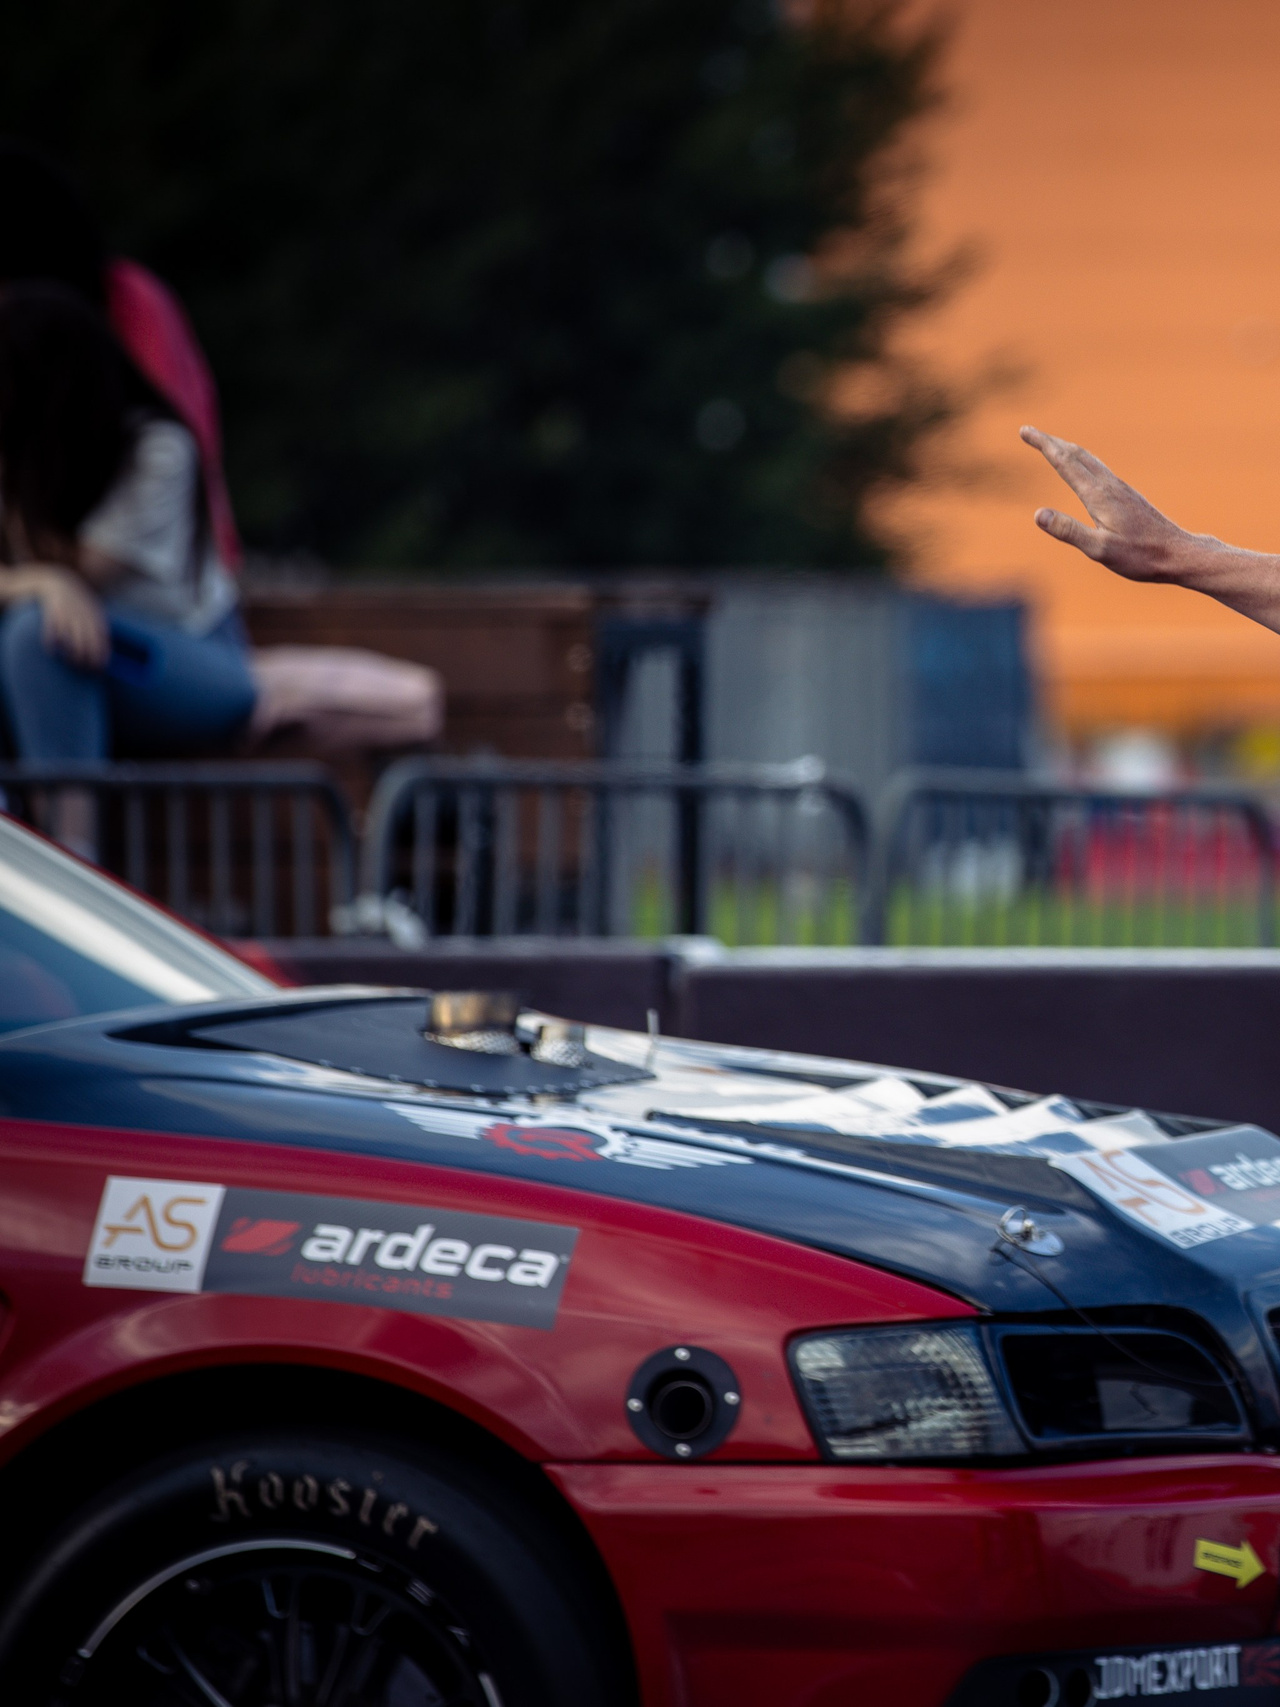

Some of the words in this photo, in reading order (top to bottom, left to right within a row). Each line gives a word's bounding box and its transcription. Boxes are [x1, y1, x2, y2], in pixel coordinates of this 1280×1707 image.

[102, 1193, 208, 1252] AS
[94, 1254, 194, 1275] GROUP
[301, 1223, 561, 1289] ardeca
[290, 1262, 454, 1299] lubricants
